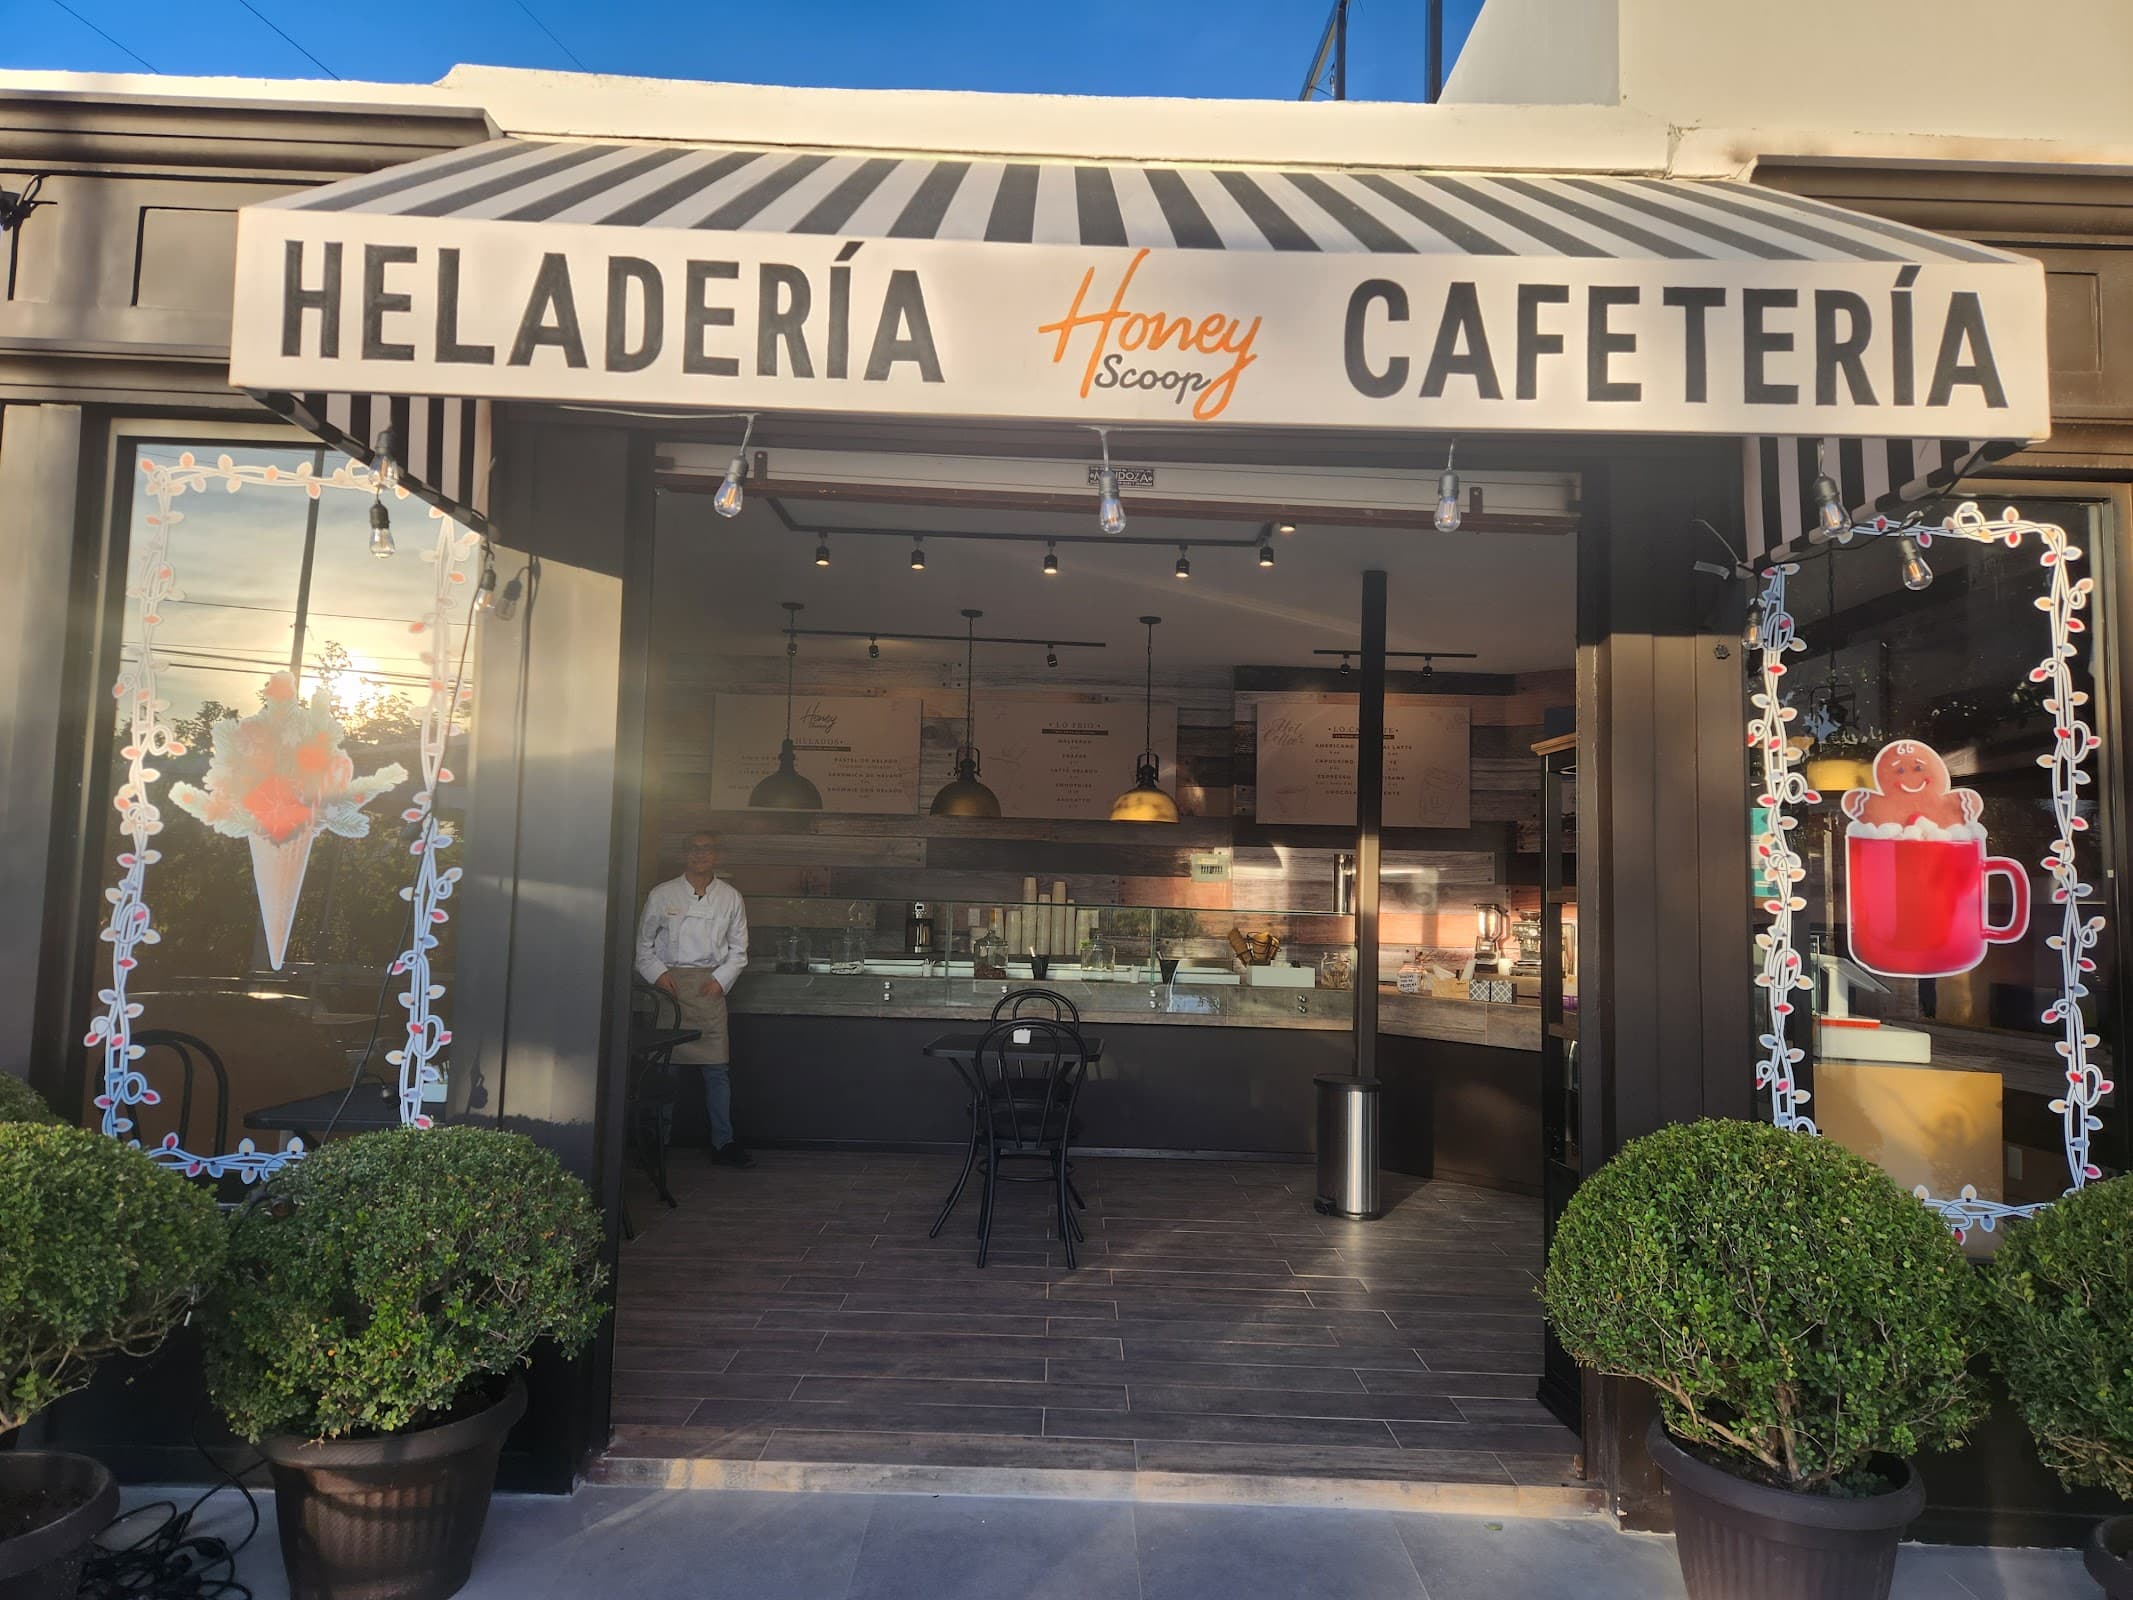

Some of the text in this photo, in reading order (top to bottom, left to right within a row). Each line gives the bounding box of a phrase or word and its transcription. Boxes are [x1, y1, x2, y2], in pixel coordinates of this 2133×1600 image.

[281, 240, 945, 383] HELADERÍA
[1038, 248, 1263, 420] Honey
[1094, 353, 1212, 405] Scoop
[1344, 264, 2009, 408] CAFETERÍA
